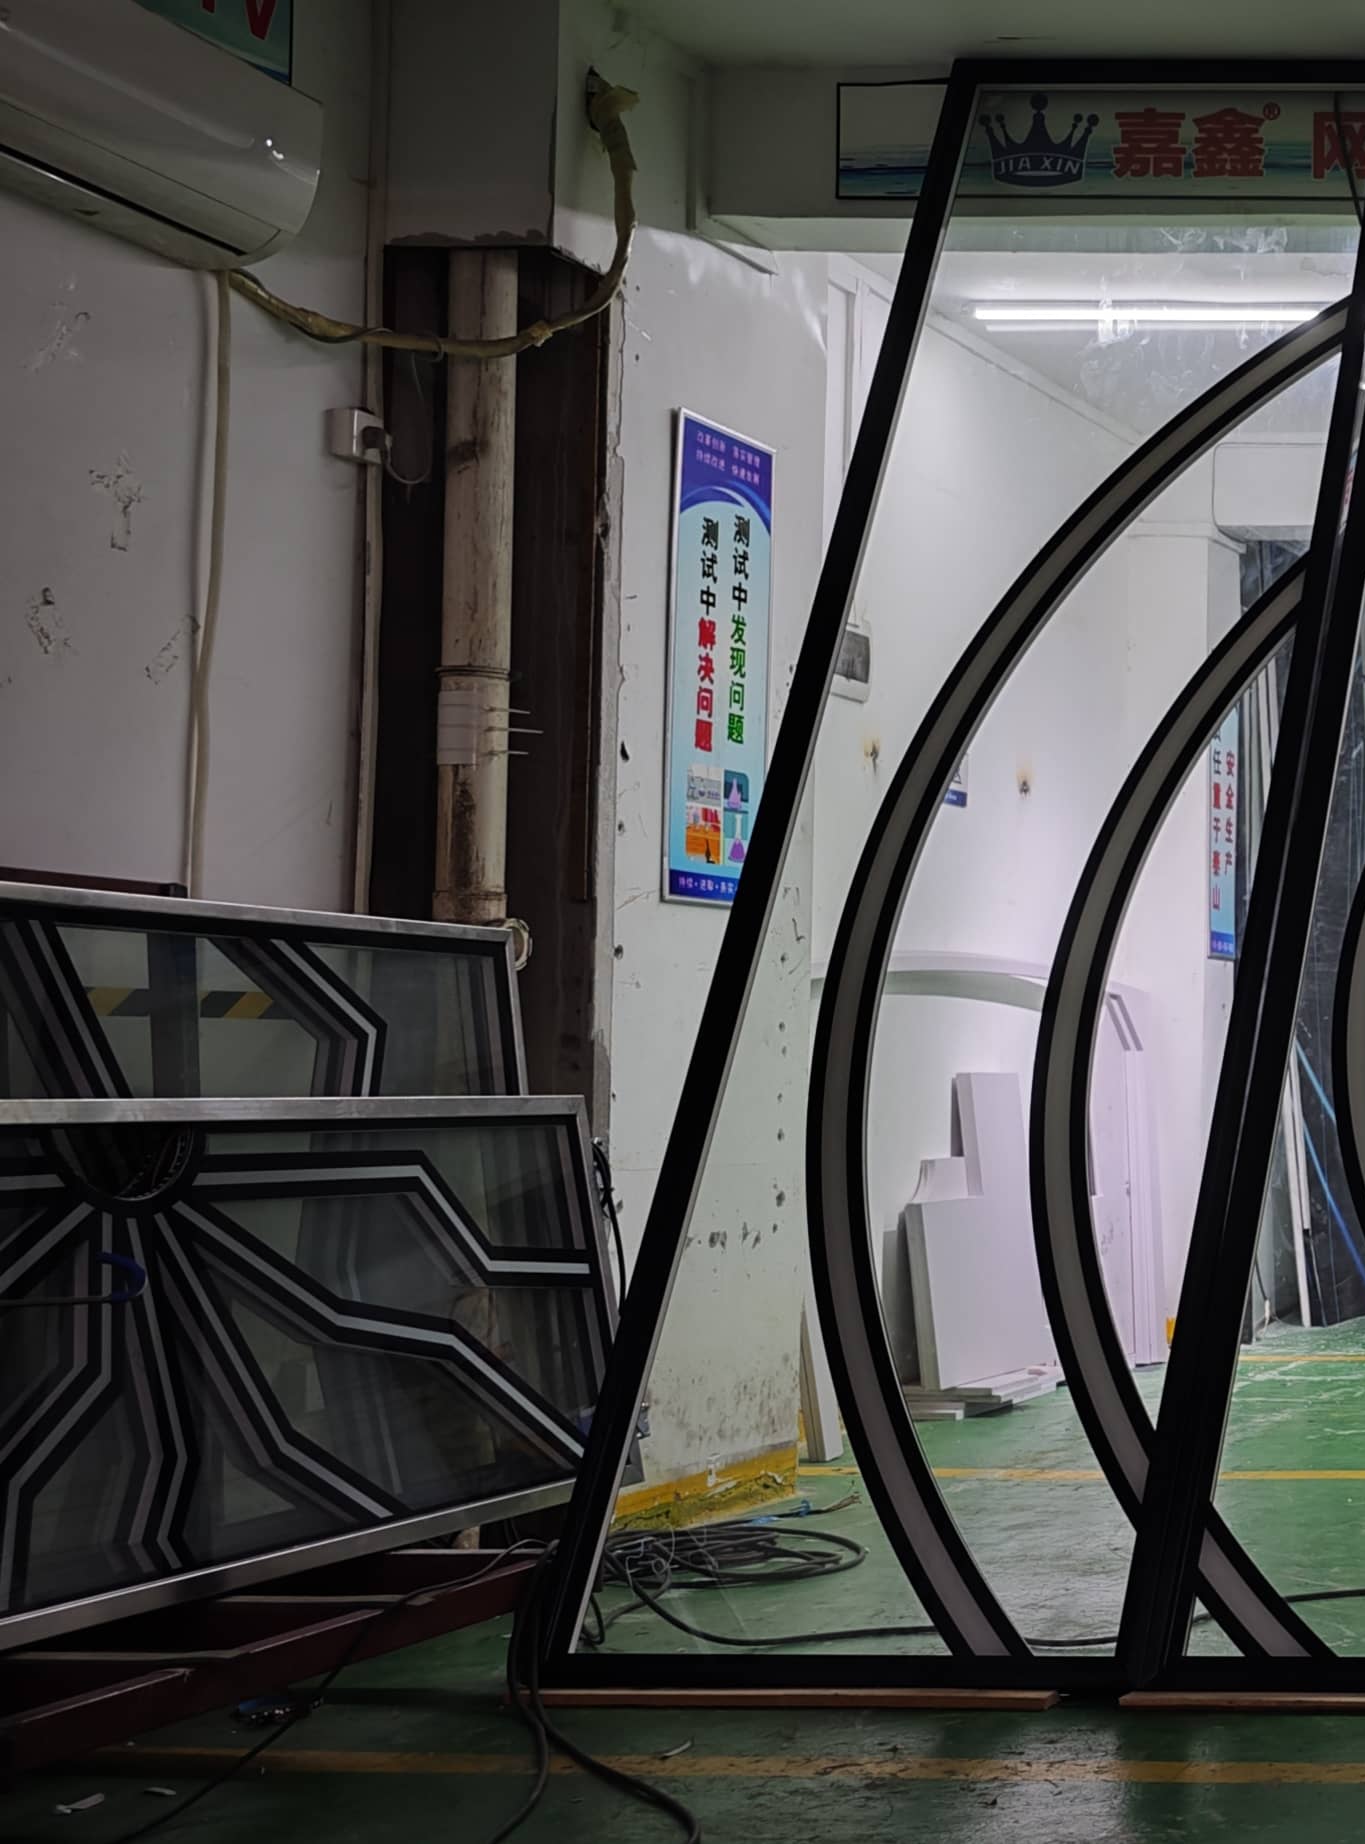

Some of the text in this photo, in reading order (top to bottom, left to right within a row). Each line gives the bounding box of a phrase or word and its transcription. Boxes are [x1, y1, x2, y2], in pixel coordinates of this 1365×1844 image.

[694, 516, 719, 752] 测试中解决问题
[728, 513, 751, 745] 测试中发现问题
